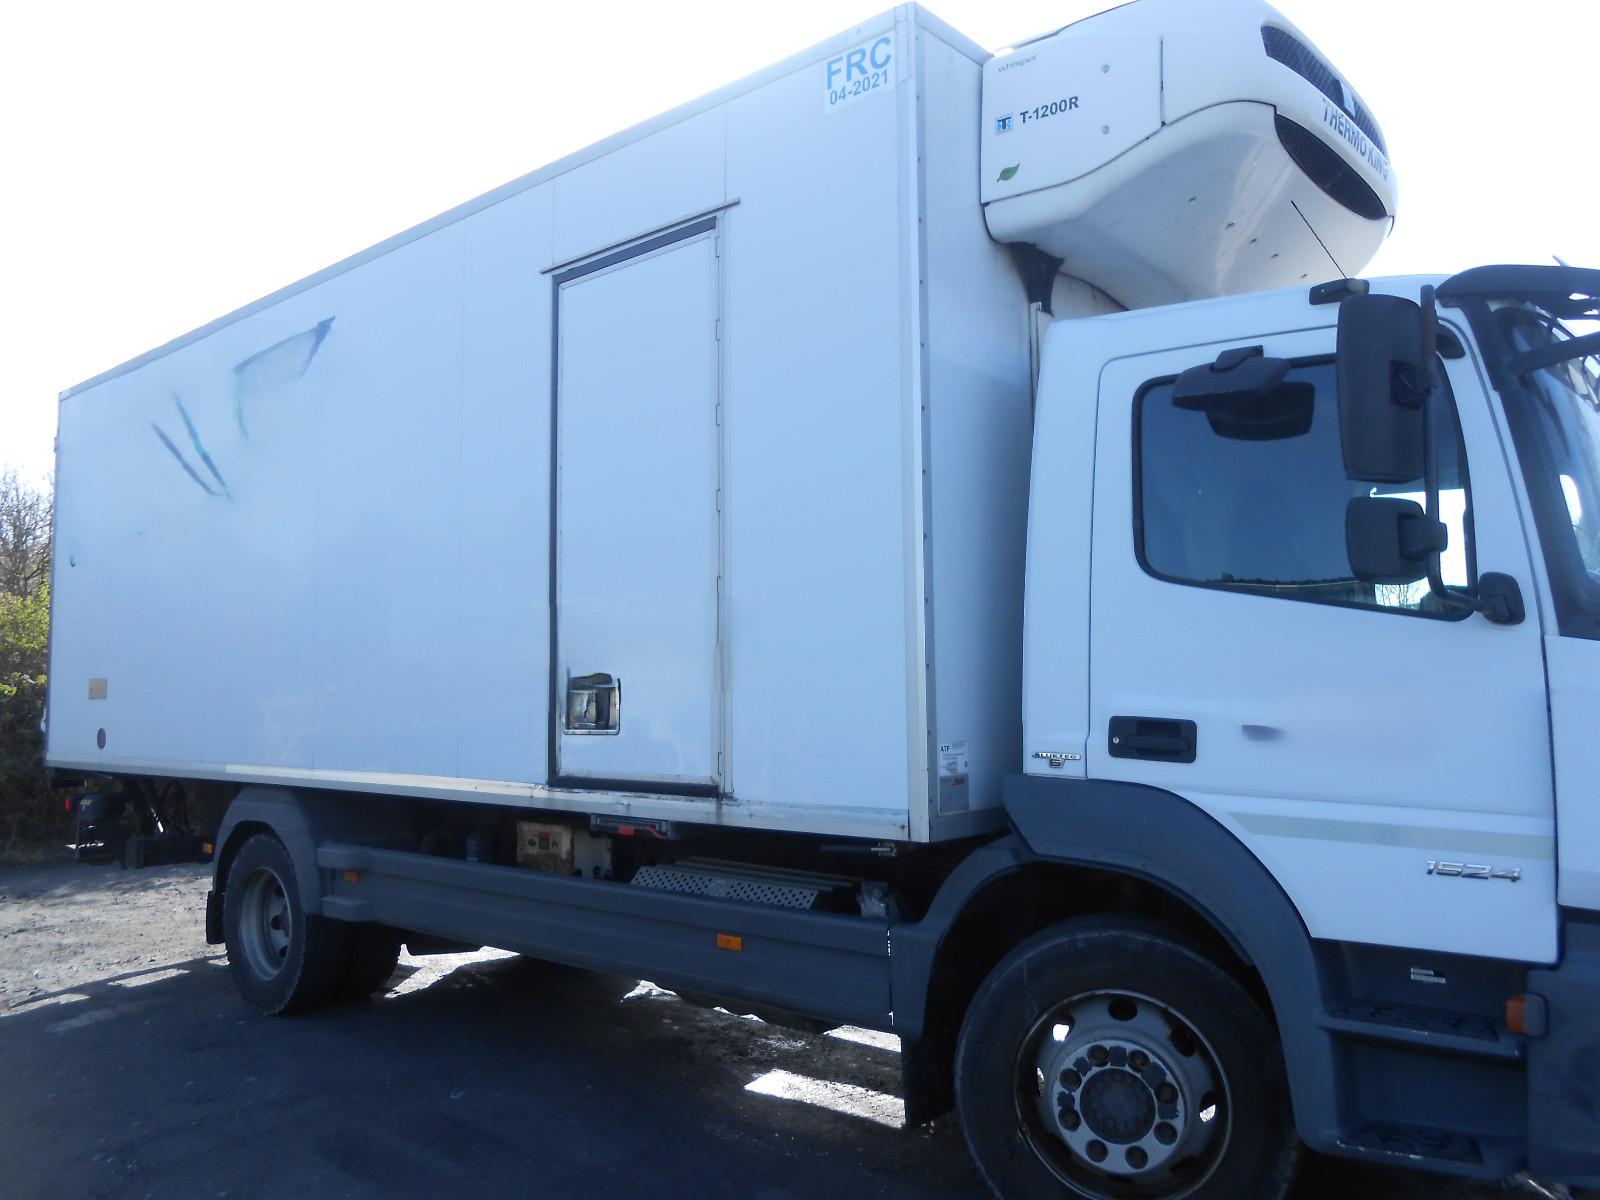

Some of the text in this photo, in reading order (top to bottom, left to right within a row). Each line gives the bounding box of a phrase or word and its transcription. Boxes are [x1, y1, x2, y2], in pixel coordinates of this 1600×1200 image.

[826, 37, 892, 90] FRC
[829, 68, 889, 105] 04-2021
[1019, 96, 1079, 124] T-1200R
[1322, 97, 1389, 181] THERMO KING
[1426, 860, 1521, 883] 1524
